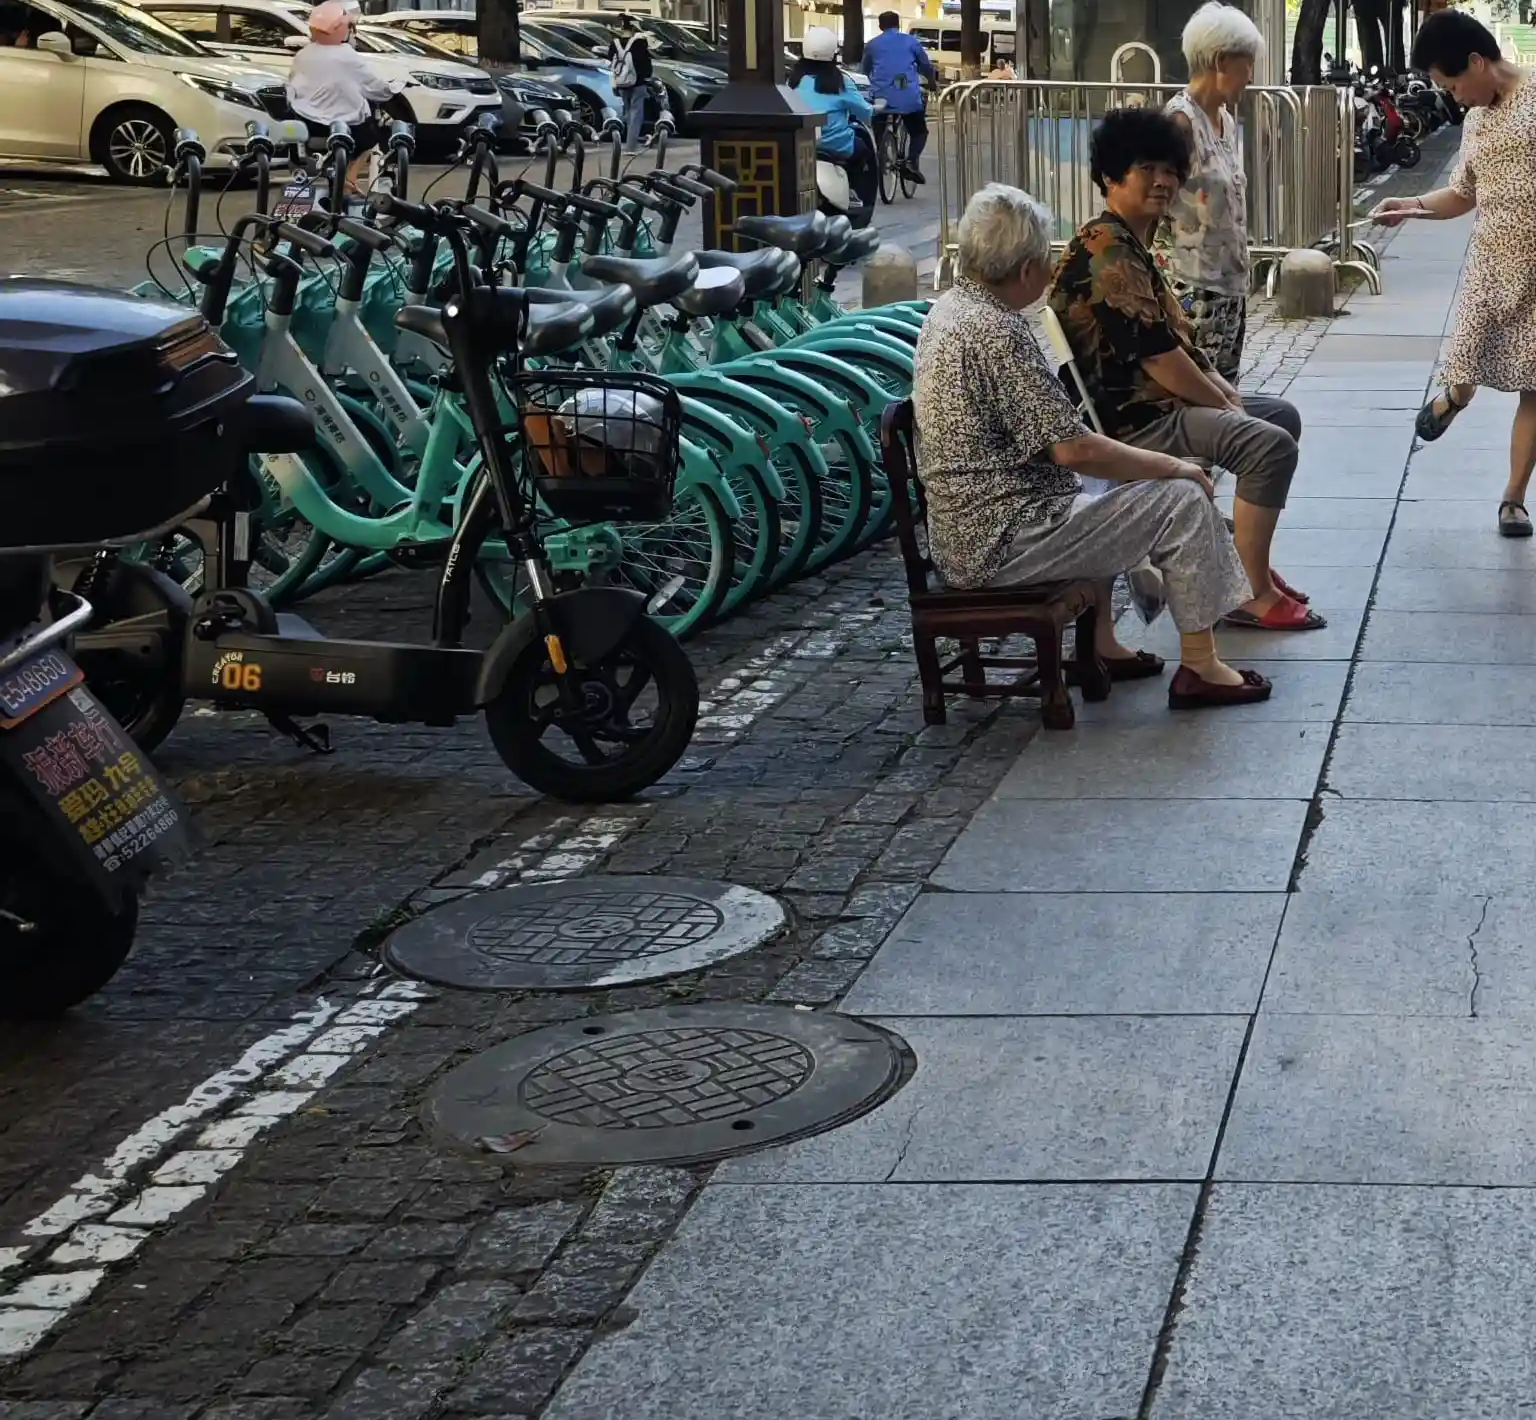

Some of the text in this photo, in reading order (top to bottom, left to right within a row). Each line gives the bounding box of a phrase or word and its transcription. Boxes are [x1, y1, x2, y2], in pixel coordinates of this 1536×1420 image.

[1, 654, 67, 710] E548650
[211, 651, 244, 685] CREATOR
[222, 662, 262, 691] 06
